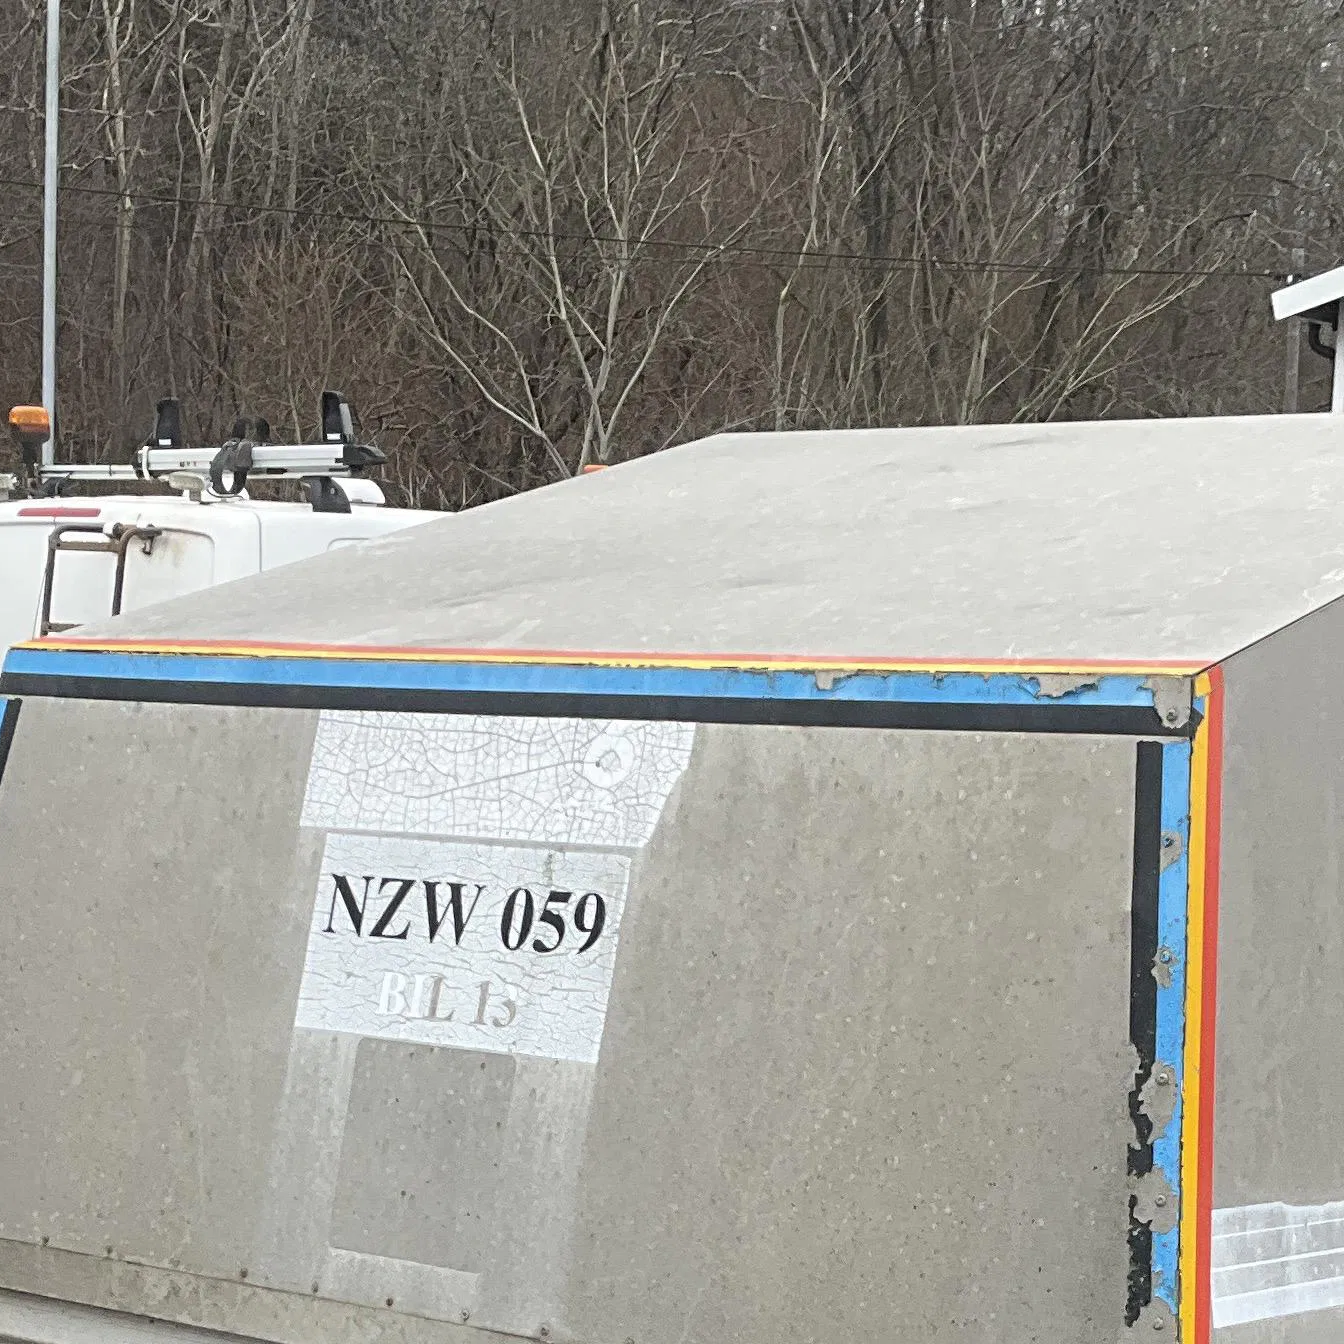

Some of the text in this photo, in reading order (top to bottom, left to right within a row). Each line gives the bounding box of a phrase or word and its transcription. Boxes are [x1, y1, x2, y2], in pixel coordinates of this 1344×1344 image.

[321, 872, 606, 956] NZW 059
[374, 970, 455, 1023] BIL
